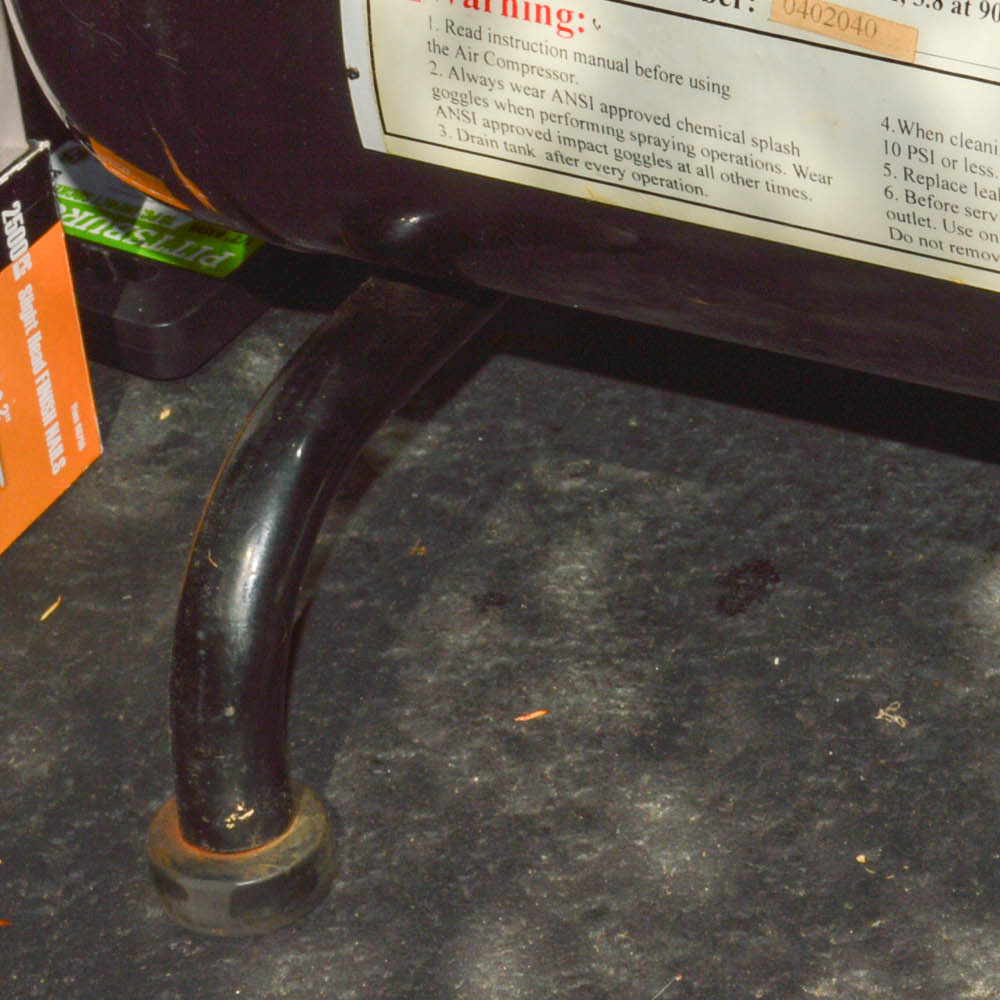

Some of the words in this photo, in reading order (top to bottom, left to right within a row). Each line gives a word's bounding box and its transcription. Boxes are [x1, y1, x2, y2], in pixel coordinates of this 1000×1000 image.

[950, 0, 971, 17] at
[427, 38, 450, 57] the
[455, 45, 480, 63] Air
[483, 51, 580, 85] Compressor.
[445, 18, 483, 41] Read
[487, 27, 568, 60] instruction
[573, 51, 629, 75] manual
[634, 59, 684, 87] before
[689, 75, 731, 101] using
[429, 60, 442, 77] 2.
[448, 65, 505, 92] Always
[509, 82, 545, 99] wear
[551, 89, 594, 111] ANSI
[599, 102, 671, 129] approved
[675, 116, 746, 145] chemical
[751, 135, 801, 157] splash
[431, 87, 489, 107] goggles
[494, 98, 535, 119] when
[539, 110, 626, 143] performing
[629, 131, 697, 159] spraying
[700, 148, 786, 175] operations.
[792, 163, 833, 185] Wear
[434, 104, 477, 125] ANSI
[482, 118, 553, 143] approved
[557, 130, 609, 156] impact
[613, 147, 673, 170] goggles
[677, 162, 692, 175] at
[696, 163, 715, 180] all
[719, 171, 761, 190] other
[765, 180, 815, 203] times.
[439, 124, 454, 140] 3.
[456, 127, 499, 149] Drain
[503, 141, 537, 158] tank
[545, 150, 581, 168] after
[584, 161, 626, 181] every
[631, 171, 708, 197] operation.
[884, 139, 902, 157] 10
[907, 144, 935, 165] PSI
[941, 157, 959, 170] or
[963, 157, 1000, 180] less.
[883, 161, 897, 179] 5.
[903, 165, 968, 195] Replace
[883, 185, 899, 201] 6.
[904, 188, 959, 215] Before
[1, 200, 29, 262] 2500
[885, 209, 937, 230] outlet.
[942, 217, 974, 238] Use
[888, 226, 914, 244] Do
[918, 237, 944, 251] not
[18, 283, 40, 336] Slight
[27, 329, 49, 375] Head
[34, 368, 58, 427] FINISH
[45, 420, 67, 476] NAILS
